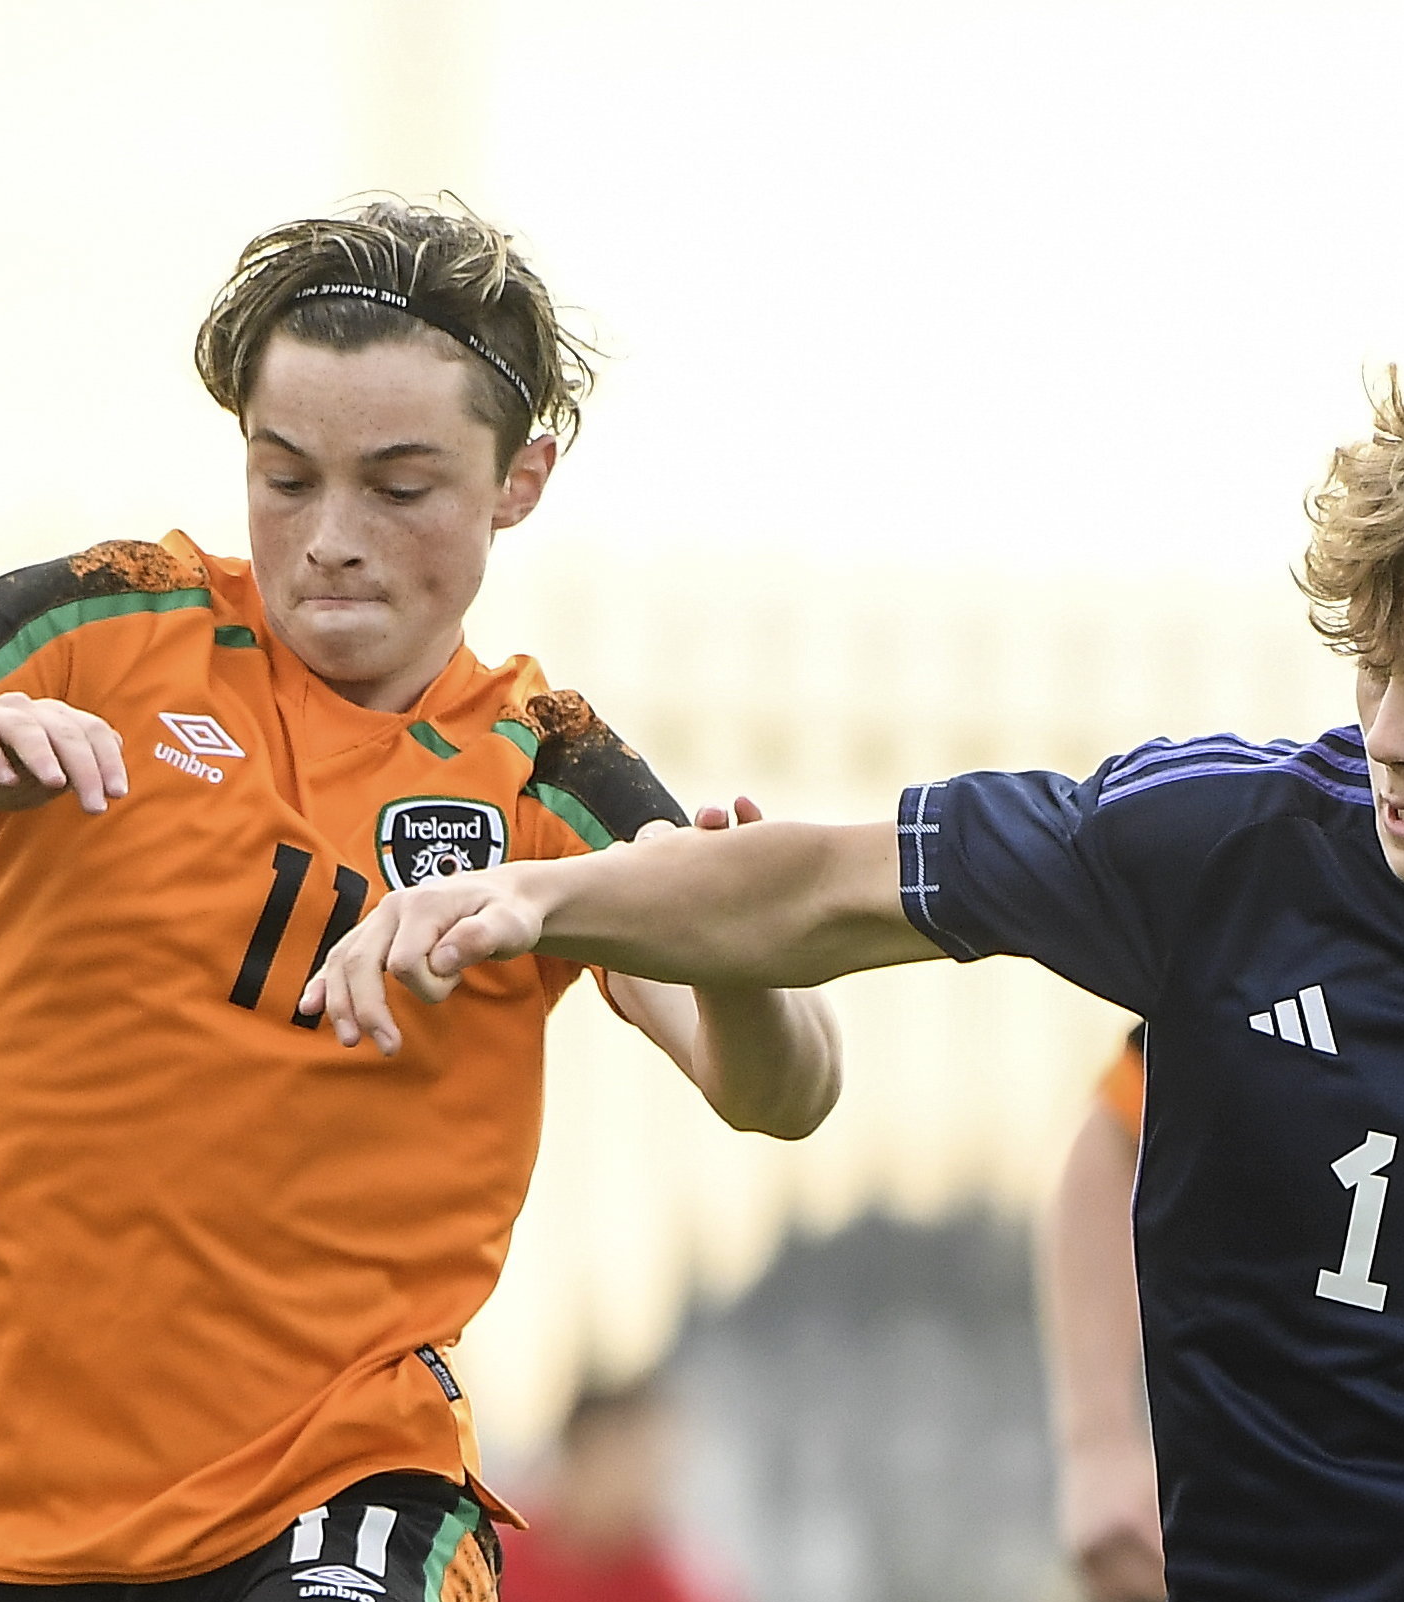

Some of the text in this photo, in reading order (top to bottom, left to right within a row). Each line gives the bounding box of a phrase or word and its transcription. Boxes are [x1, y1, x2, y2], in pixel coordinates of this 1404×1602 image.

[153, 742, 225, 785] umbro
[402, 814, 482, 842] Ireland
[229, 842, 370, 1030] 11
